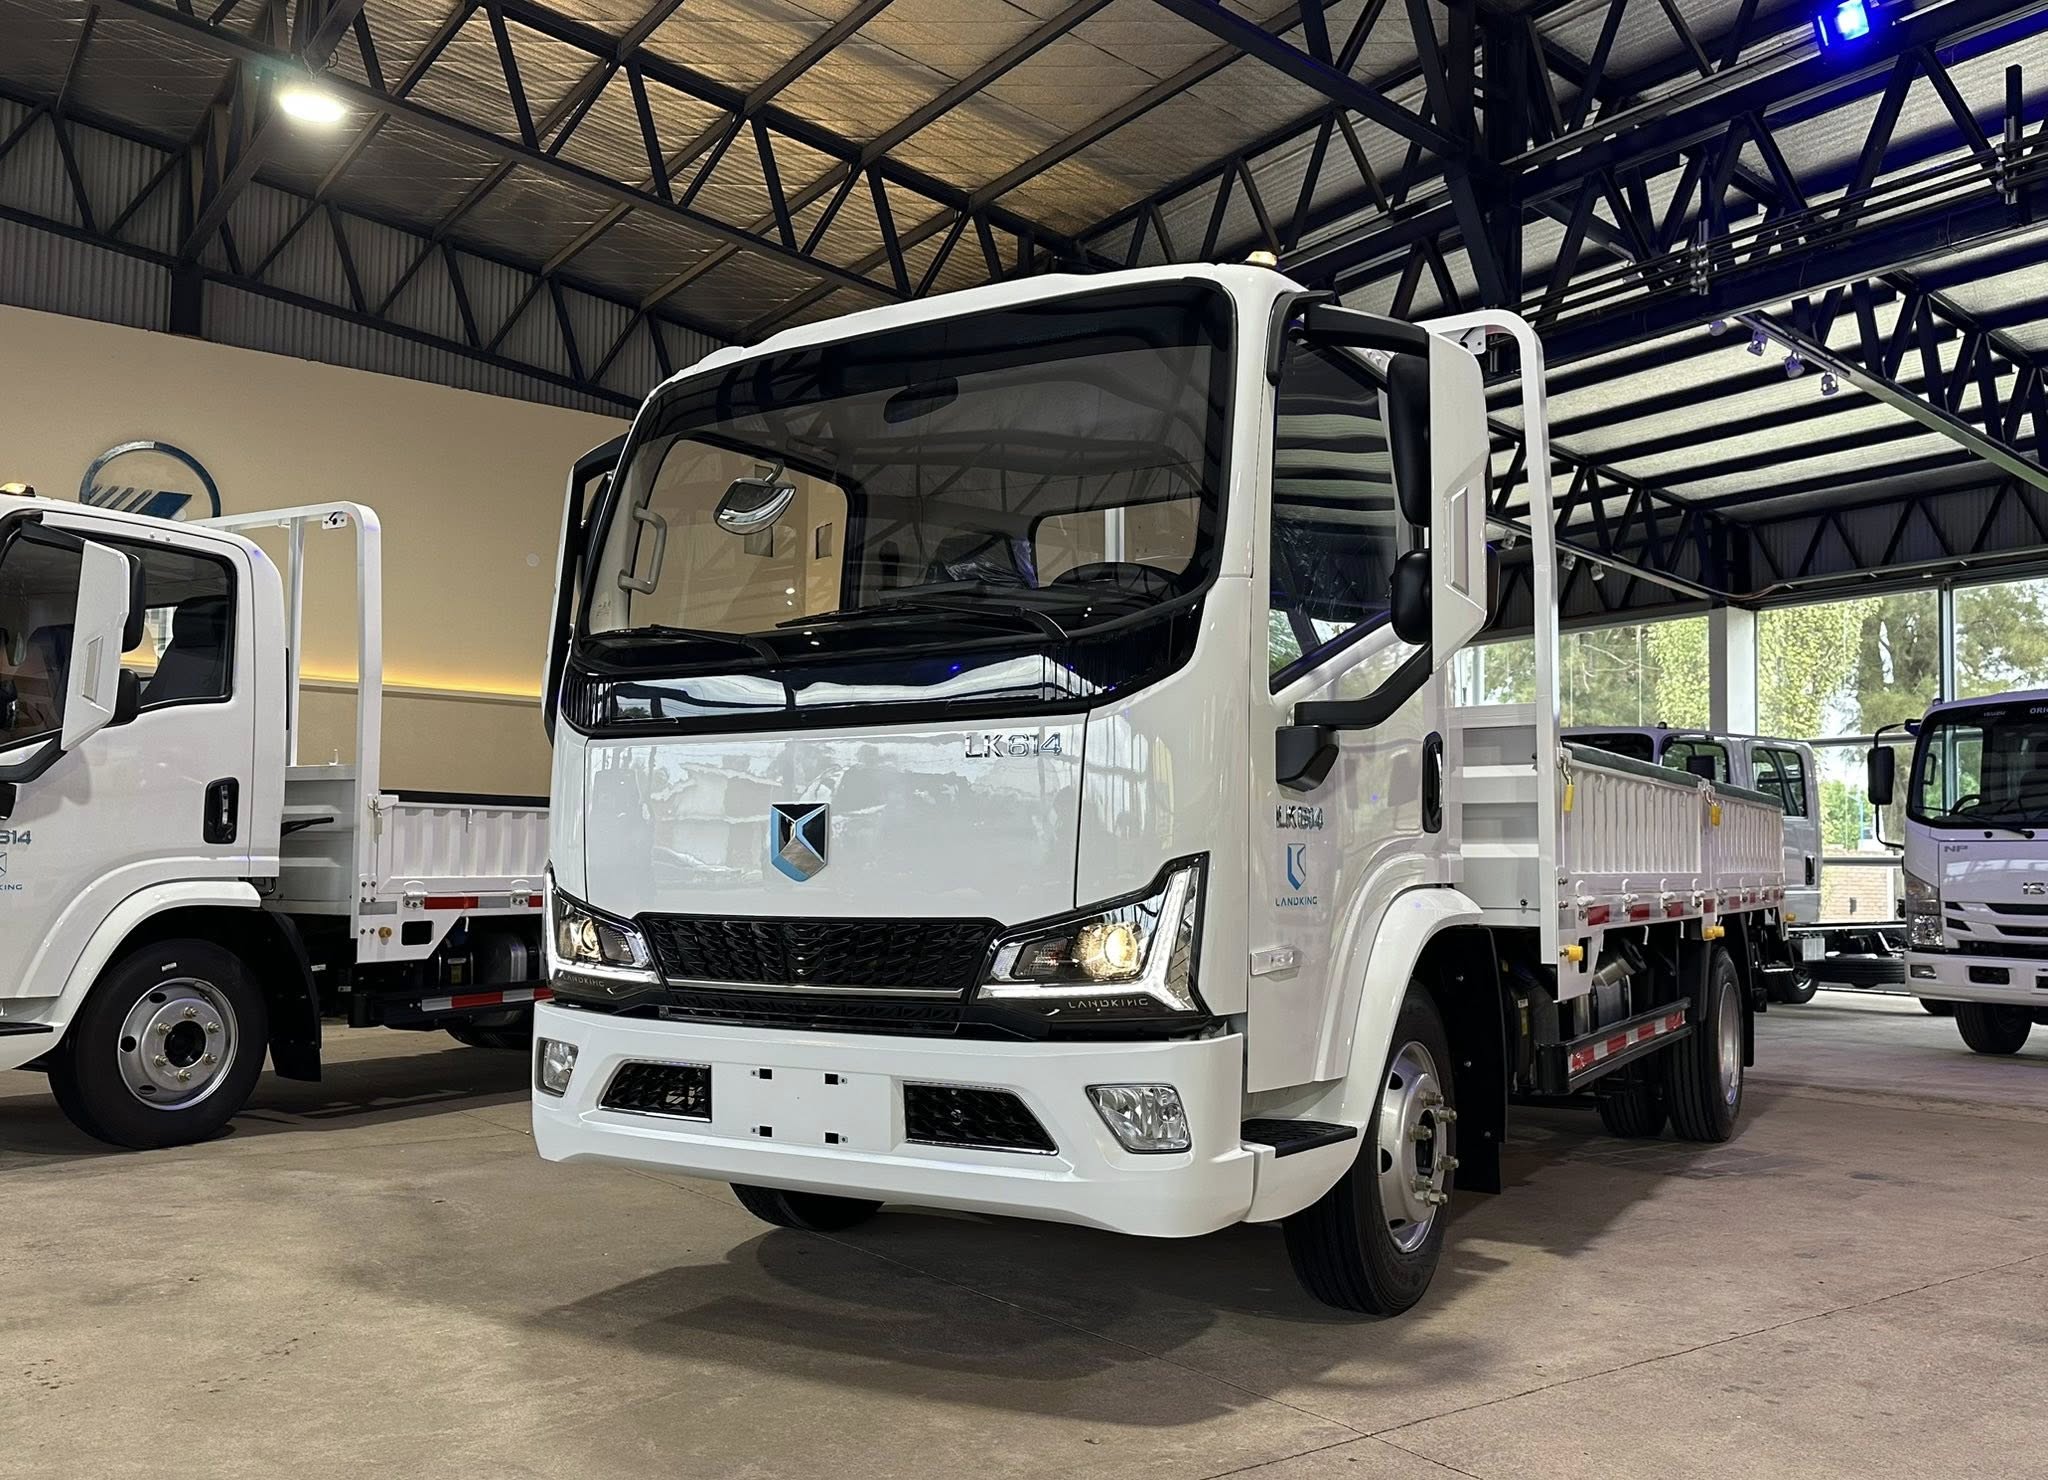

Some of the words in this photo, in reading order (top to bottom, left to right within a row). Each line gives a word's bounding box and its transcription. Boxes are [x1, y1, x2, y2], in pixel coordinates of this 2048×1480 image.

[2030, 706, 2048, 714] ORI
[965, 733, 1062, 758] LK614
[2023, 882, 2048, 895] IS
[1275, 896, 1318, 906] LANDKING
[1068, 998, 1148, 1009] LANDKING
